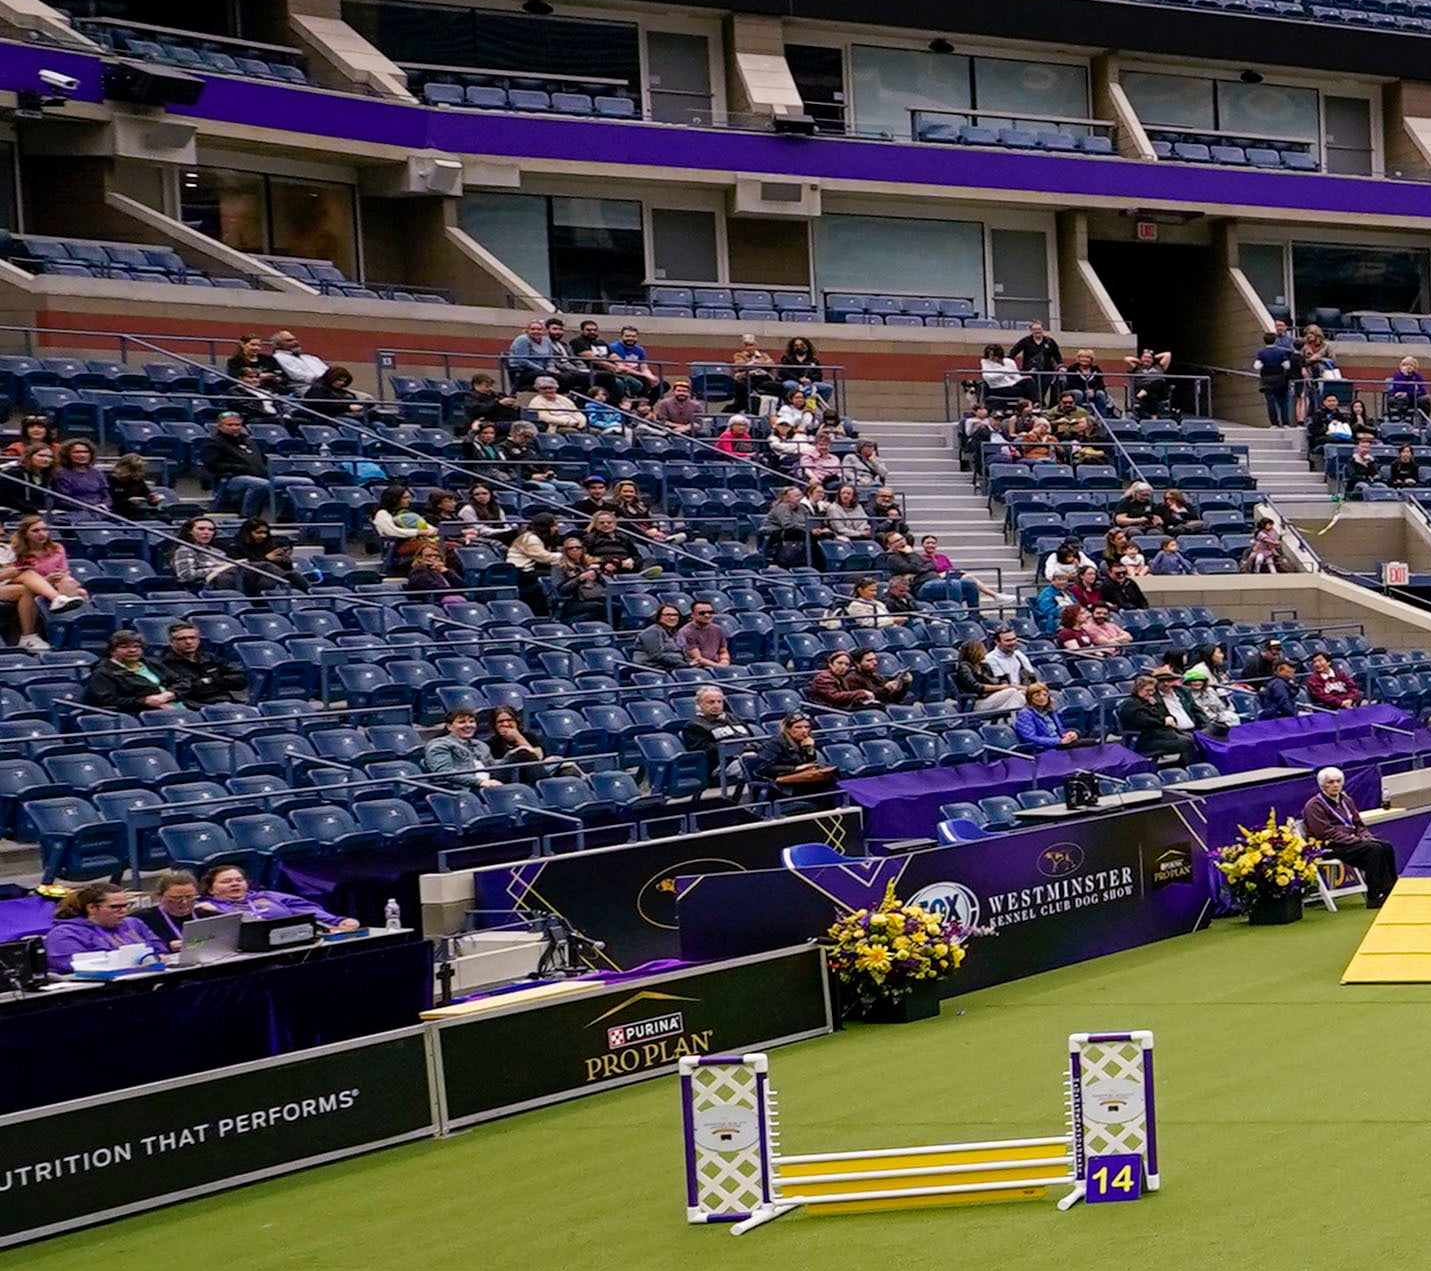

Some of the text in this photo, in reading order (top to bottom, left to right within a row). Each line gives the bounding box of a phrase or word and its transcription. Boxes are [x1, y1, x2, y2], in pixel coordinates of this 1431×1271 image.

[1389, 567, 1406, 583] EXIT
[988, 866, 1133, 914] WESTMINSTER
[989, 884, 1134, 930] KENNEL CLUB DOG SHOW
[626, 1015, 680, 1041] PURINA
[584, 1048, 640, 1081] PRO
[0, 1142, 131, 1192] UTRITION
[140, 1124, 209, 1156] THAT
[1092, 1164, 1135, 1195] 14
